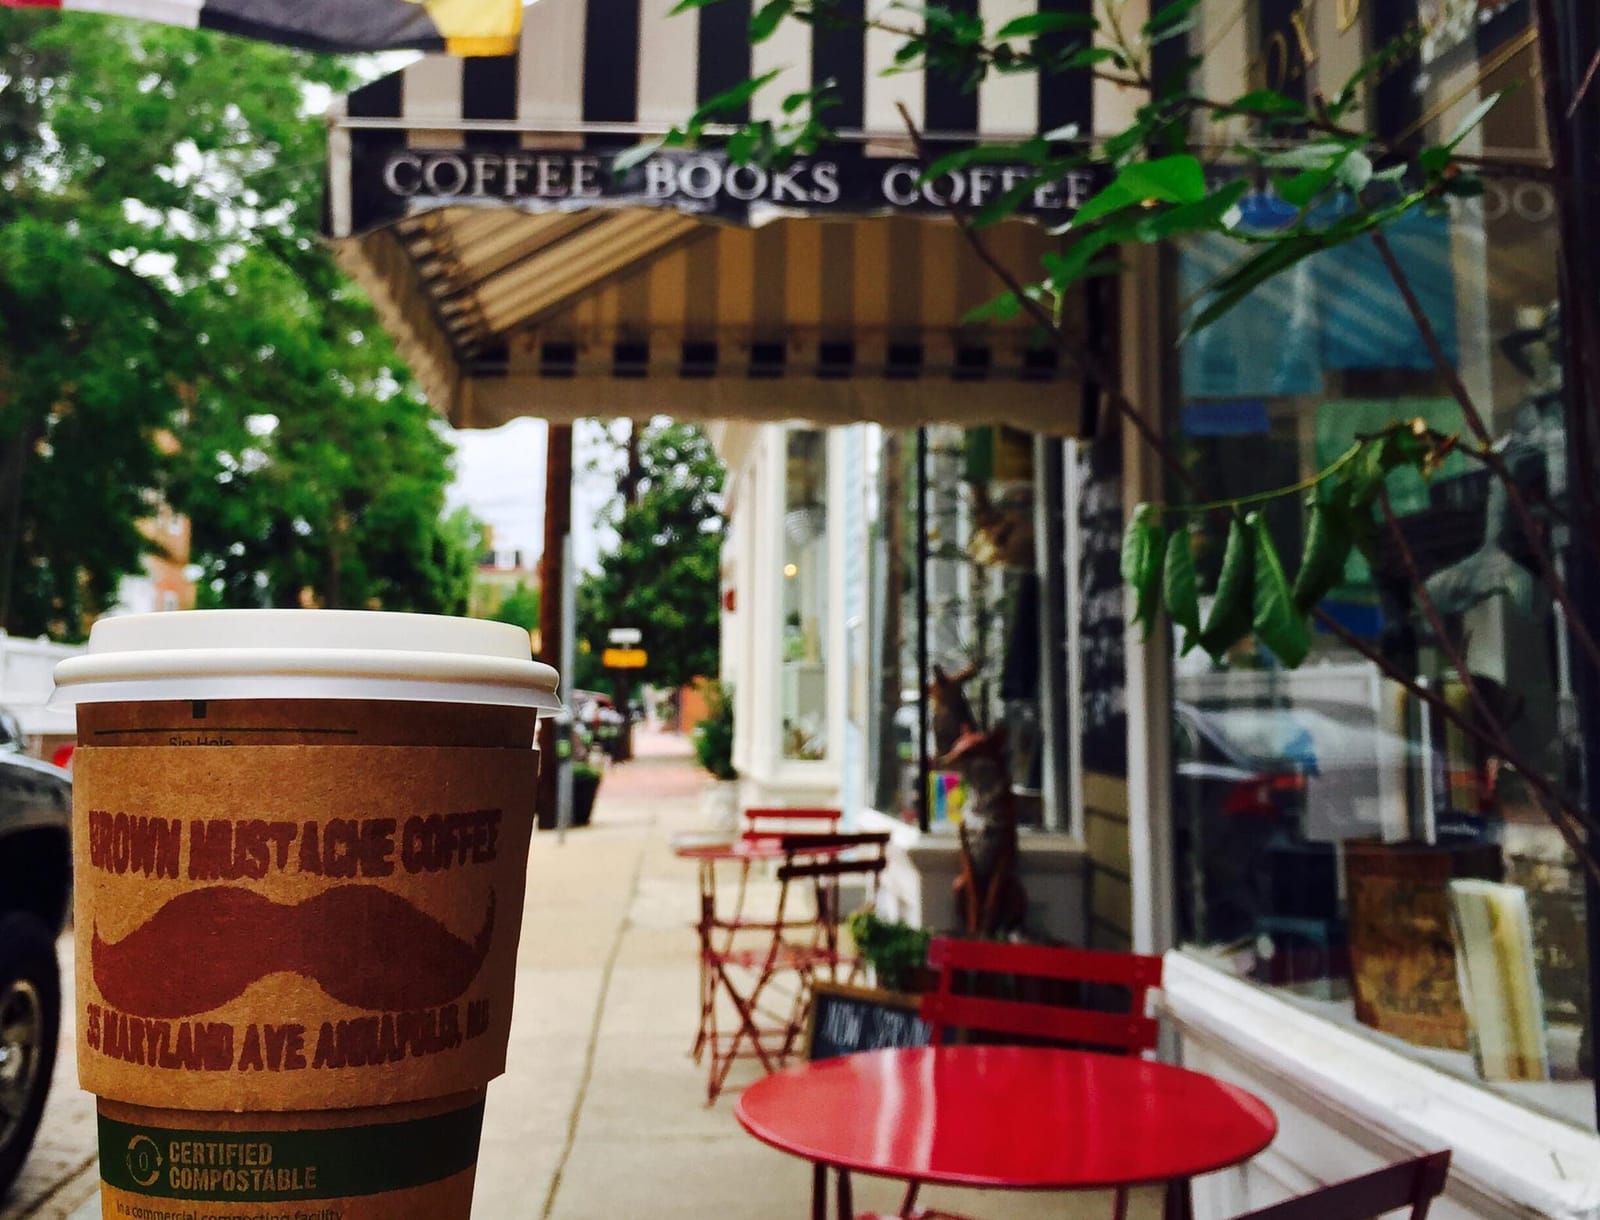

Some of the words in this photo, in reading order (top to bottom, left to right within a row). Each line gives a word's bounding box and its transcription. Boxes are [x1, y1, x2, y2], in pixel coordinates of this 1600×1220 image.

[383, 152, 601, 198] COFFEE
[645, 157, 840, 203] BOOKS
[89, 810, 182, 880] BROWN
[402, 808, 503, 875] COFFEE
[103, 1009, 234, 1072] MARYLAND
[238, 1023, 307, 1073] AVE
[169, 1141, 273, 1166] CERTIFIED
[169, 1166, 317, 1193] COMPOSTABLE
[132, 1206, 198, 1220] commercial
